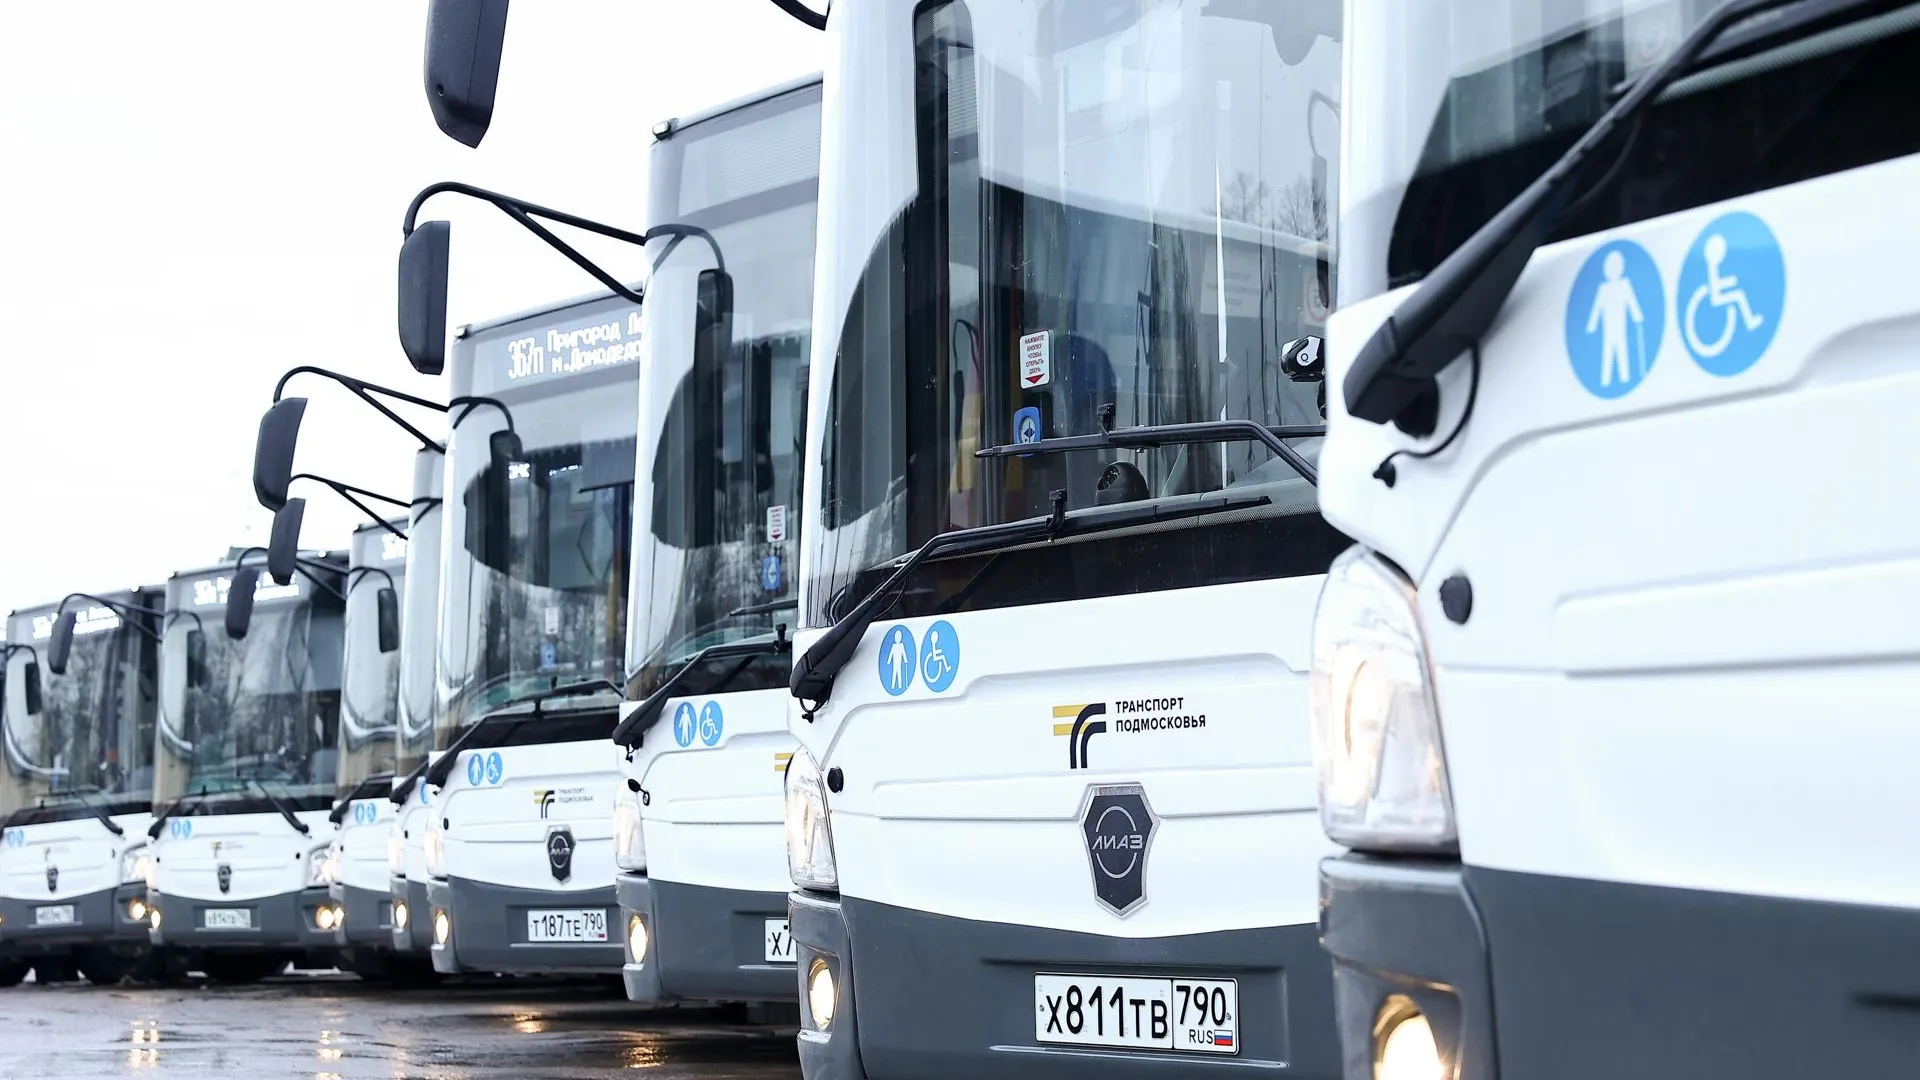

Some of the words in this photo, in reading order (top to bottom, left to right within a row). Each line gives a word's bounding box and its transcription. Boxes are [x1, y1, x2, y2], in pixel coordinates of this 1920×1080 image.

[547, 322, 621, 352] Пригород
[1115, 697, 1184, 714] ТРАНСПОРТ
[1115, 715, 1206, 733] ПОДМОСКОВЬЯ
[1092, 834, 1143, 850] ЛИАЗ
[533, 914, 581, 938] Т187ТЕ
[583, 912, 603, 930] 790
[1045, 984, 1169, 1039] Х811ТВ
[1176, 985, 1226, 1027] 790
[1188, 1029, 1214, 1045] RUS
